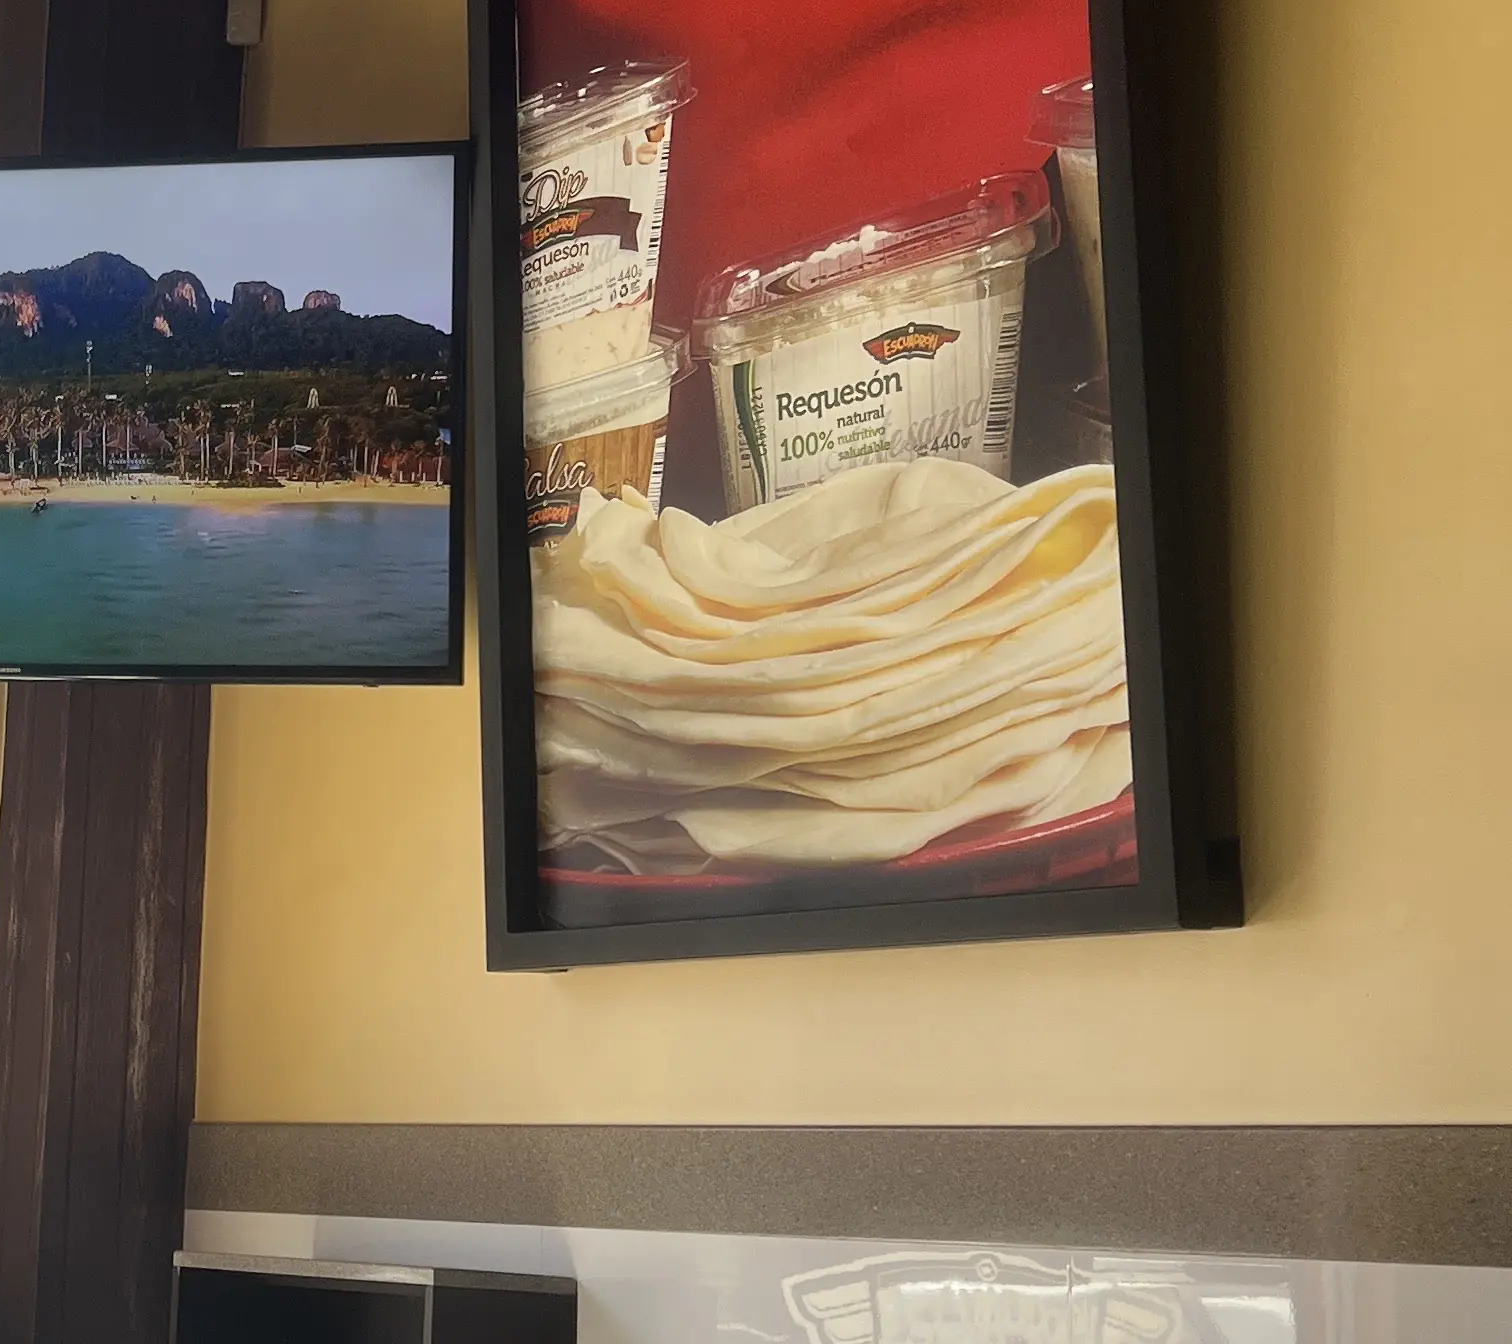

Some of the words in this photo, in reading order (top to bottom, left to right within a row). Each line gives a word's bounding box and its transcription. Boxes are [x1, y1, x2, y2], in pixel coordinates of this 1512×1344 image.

[522, 165, 589, 223] Dip
[519, 238, 590, 279] equesón
[522, 275, 543, 293] 00%
[775, 369, 903, 421] Requesón
[836, 404, 885, 429] natural
[780, 429, 835, 462] 100%
[837, 425, 886, 446] nutritivo
[837, 439, 891, 462] saludable
[522, 441, 594, 501] alsa
